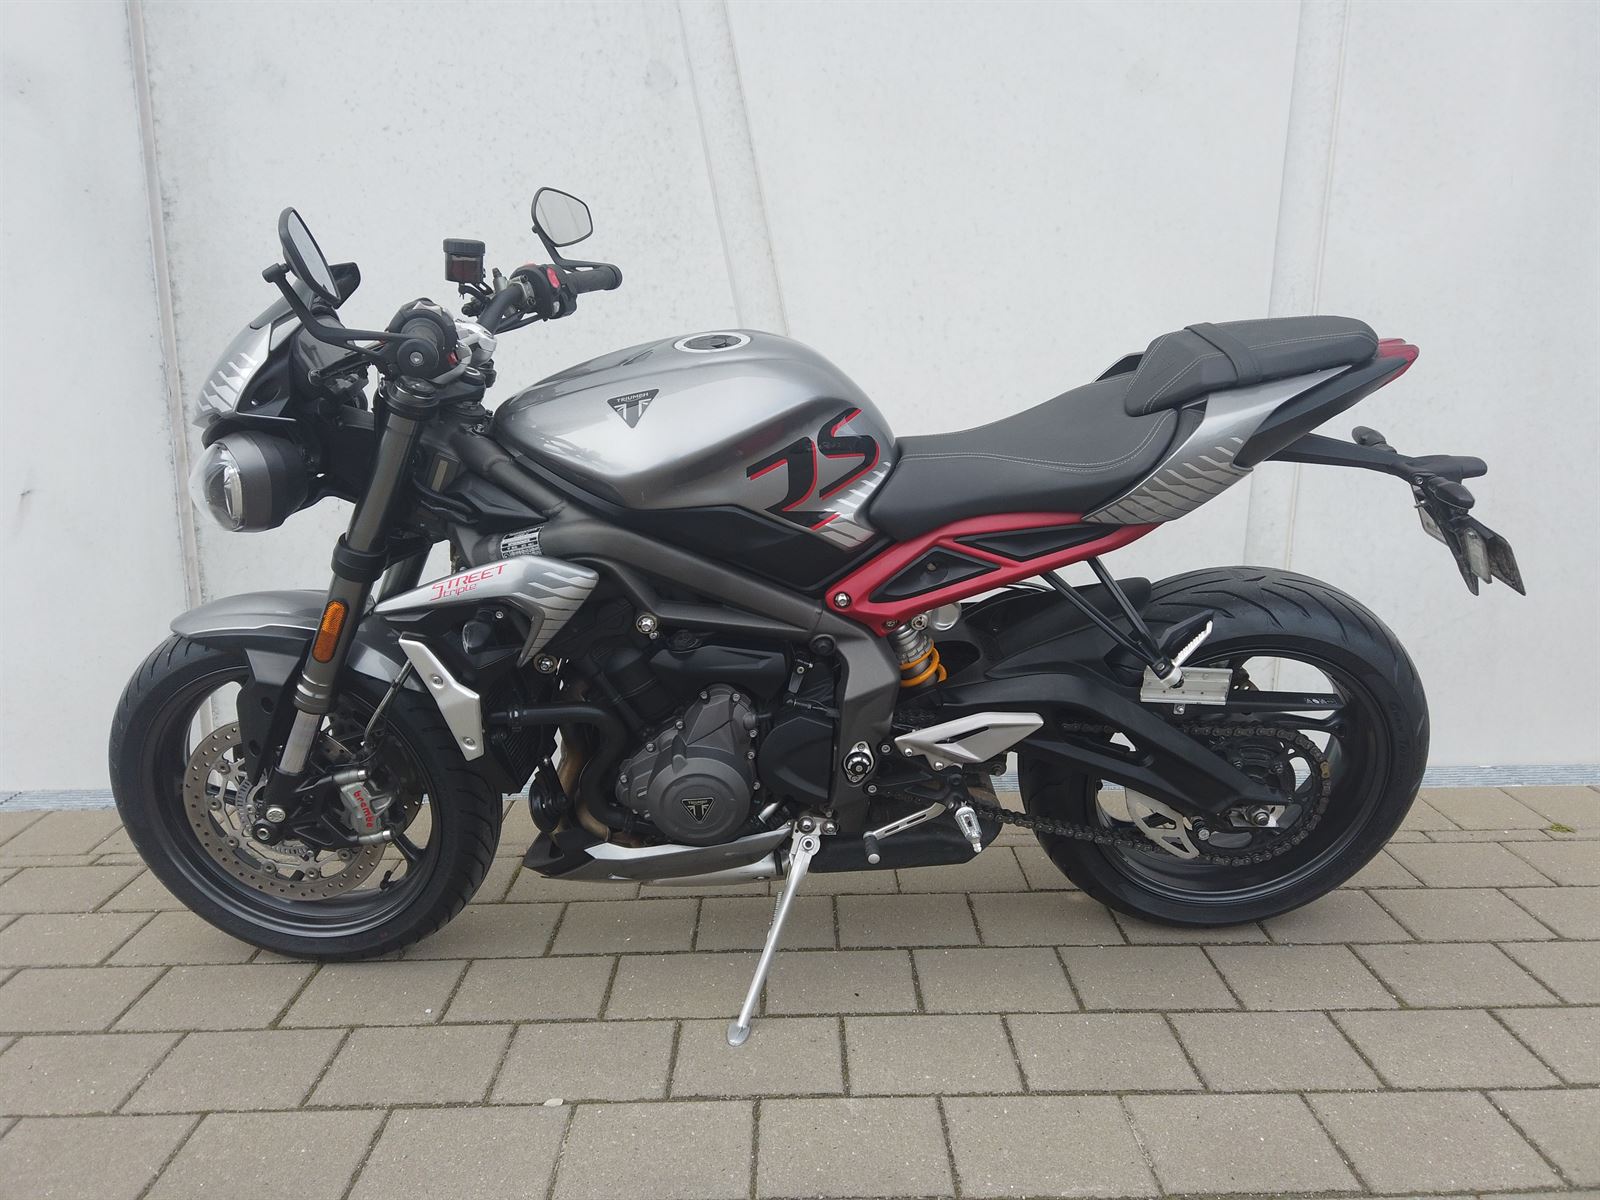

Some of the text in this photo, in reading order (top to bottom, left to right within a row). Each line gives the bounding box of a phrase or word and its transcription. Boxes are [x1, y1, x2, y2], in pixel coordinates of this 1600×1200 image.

[617, 392, 649, 402] TRIUMPH
[430, 563, 507, 601] STREET
[443, 584, 477, 598] triple
[353, 790, 374, 828] brembo
